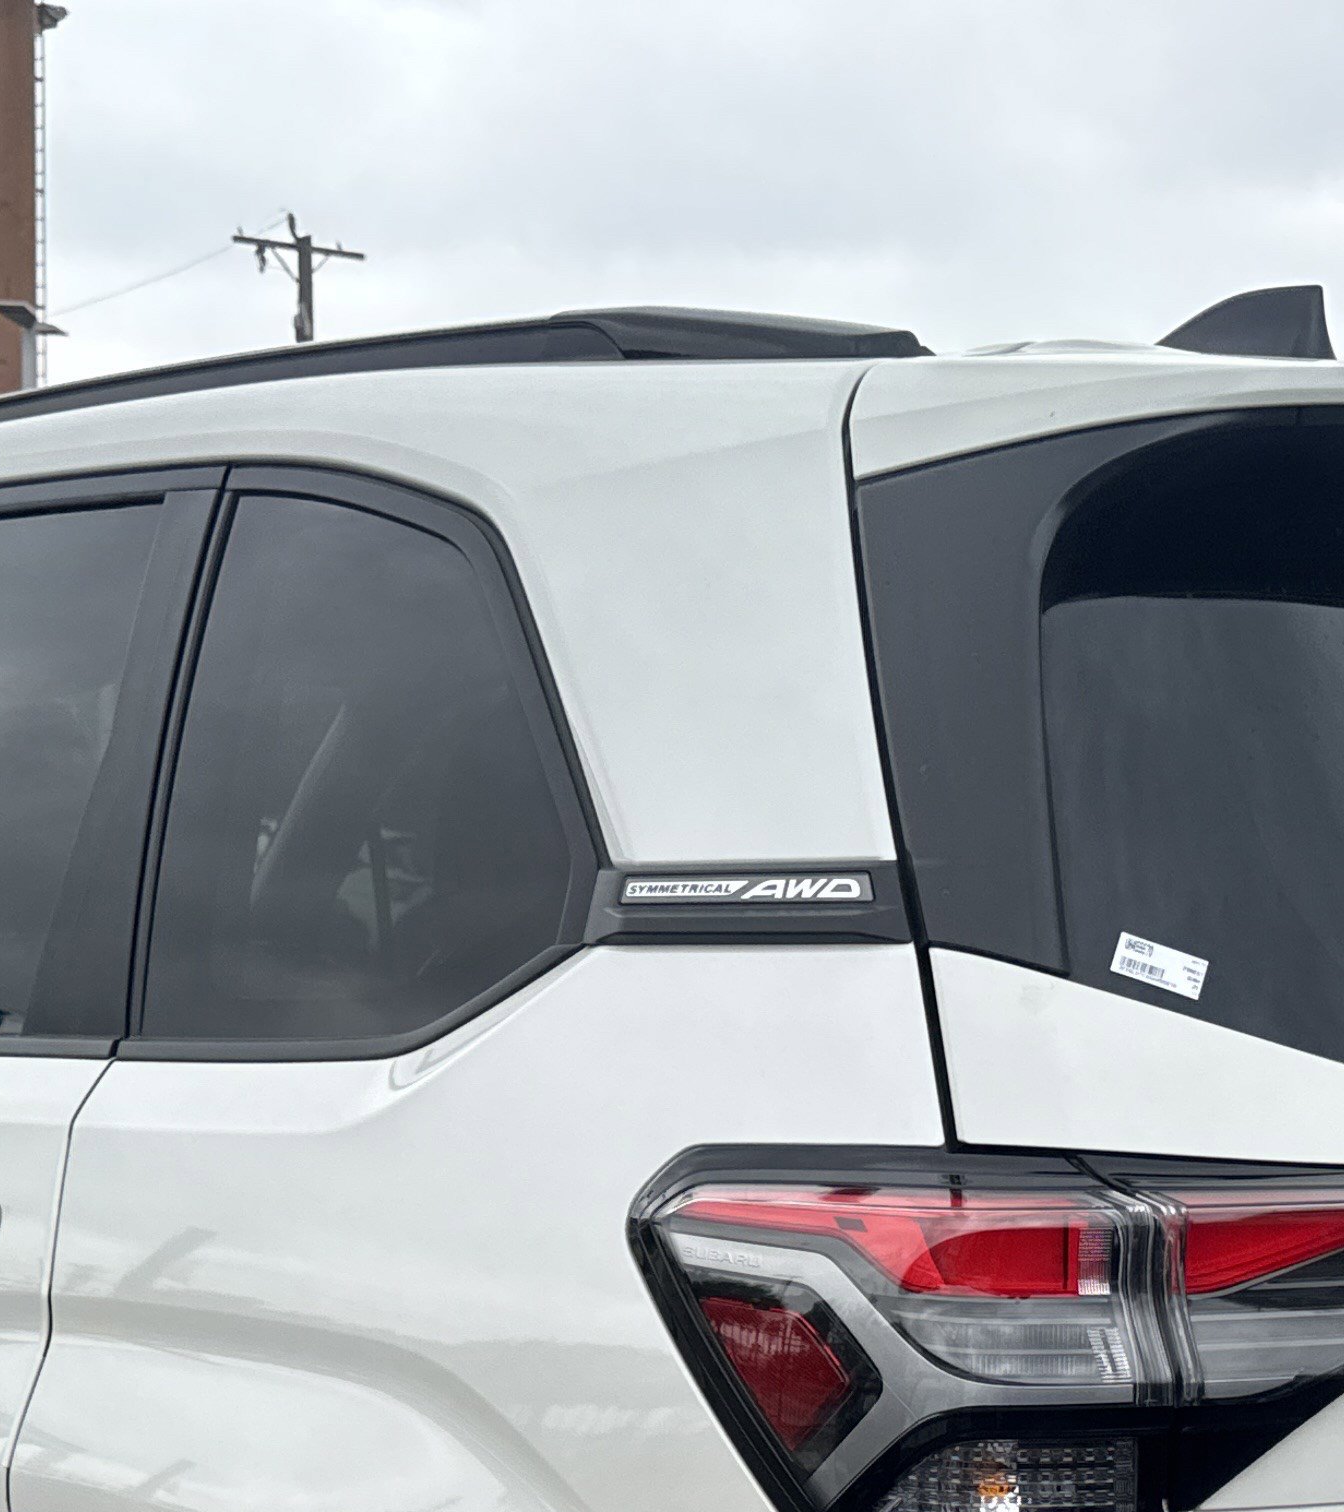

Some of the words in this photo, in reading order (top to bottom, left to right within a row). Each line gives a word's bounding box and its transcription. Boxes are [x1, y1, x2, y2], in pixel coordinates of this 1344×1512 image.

[627, 881, 735, 896] SYMMETRICAL
[741, 878, 861, 899] AWD
[682, 1246, 760, 1268] SUBARU
